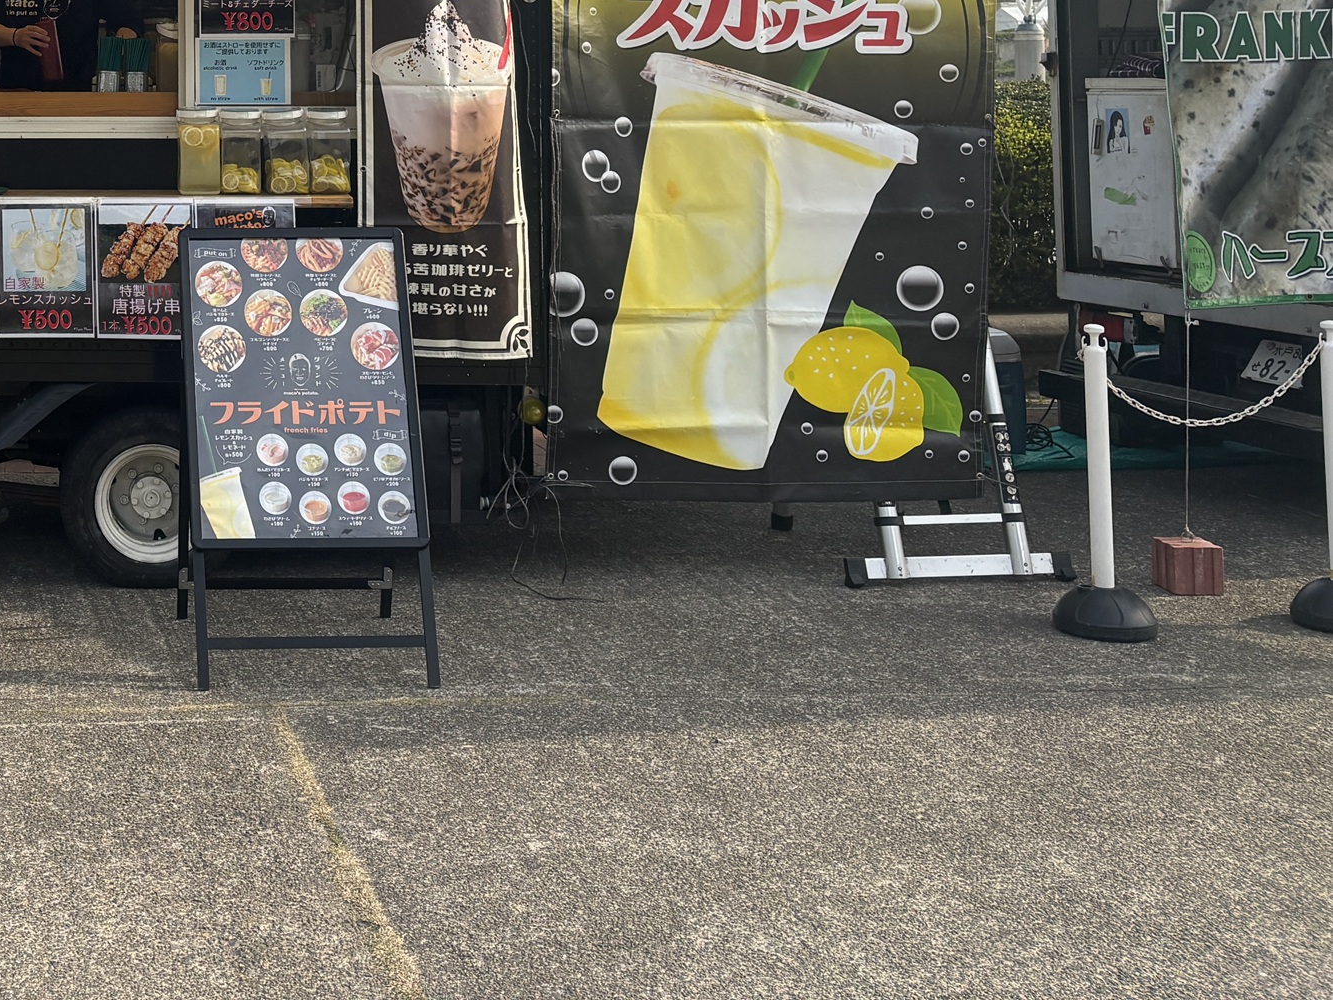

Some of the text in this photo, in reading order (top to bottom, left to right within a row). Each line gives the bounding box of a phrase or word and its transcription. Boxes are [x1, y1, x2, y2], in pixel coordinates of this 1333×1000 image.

[203, 0, 293, 9] ミート&チェダーチーズ
[221, 11, 274, 31] ¥800
[1162, 10, 1333, 62] FRANK
[203, 41, 281, 49] お酒はストローを使用せずに
[214, 208, 263, 227] maco's
[411, 243, 488, 258] 香り華やぐ
[1221, 230, 1333, 283] ハース
[4, 276, 46, 291] 自家製
[408, 282, 497, 298] 練乳の甘さが
[112, 299, 180, 316] 唐揚げ串
[412, 301, 488, 317] 堪らない!!!
[17, 309, 73, 331] ¥500
[102, 316, 173, 335] 1本 ¥500
[210, 398, 400, 425] フライドポテト
[283, 426, 328, 434] french fries
[383, 431, 397, 439] dip
